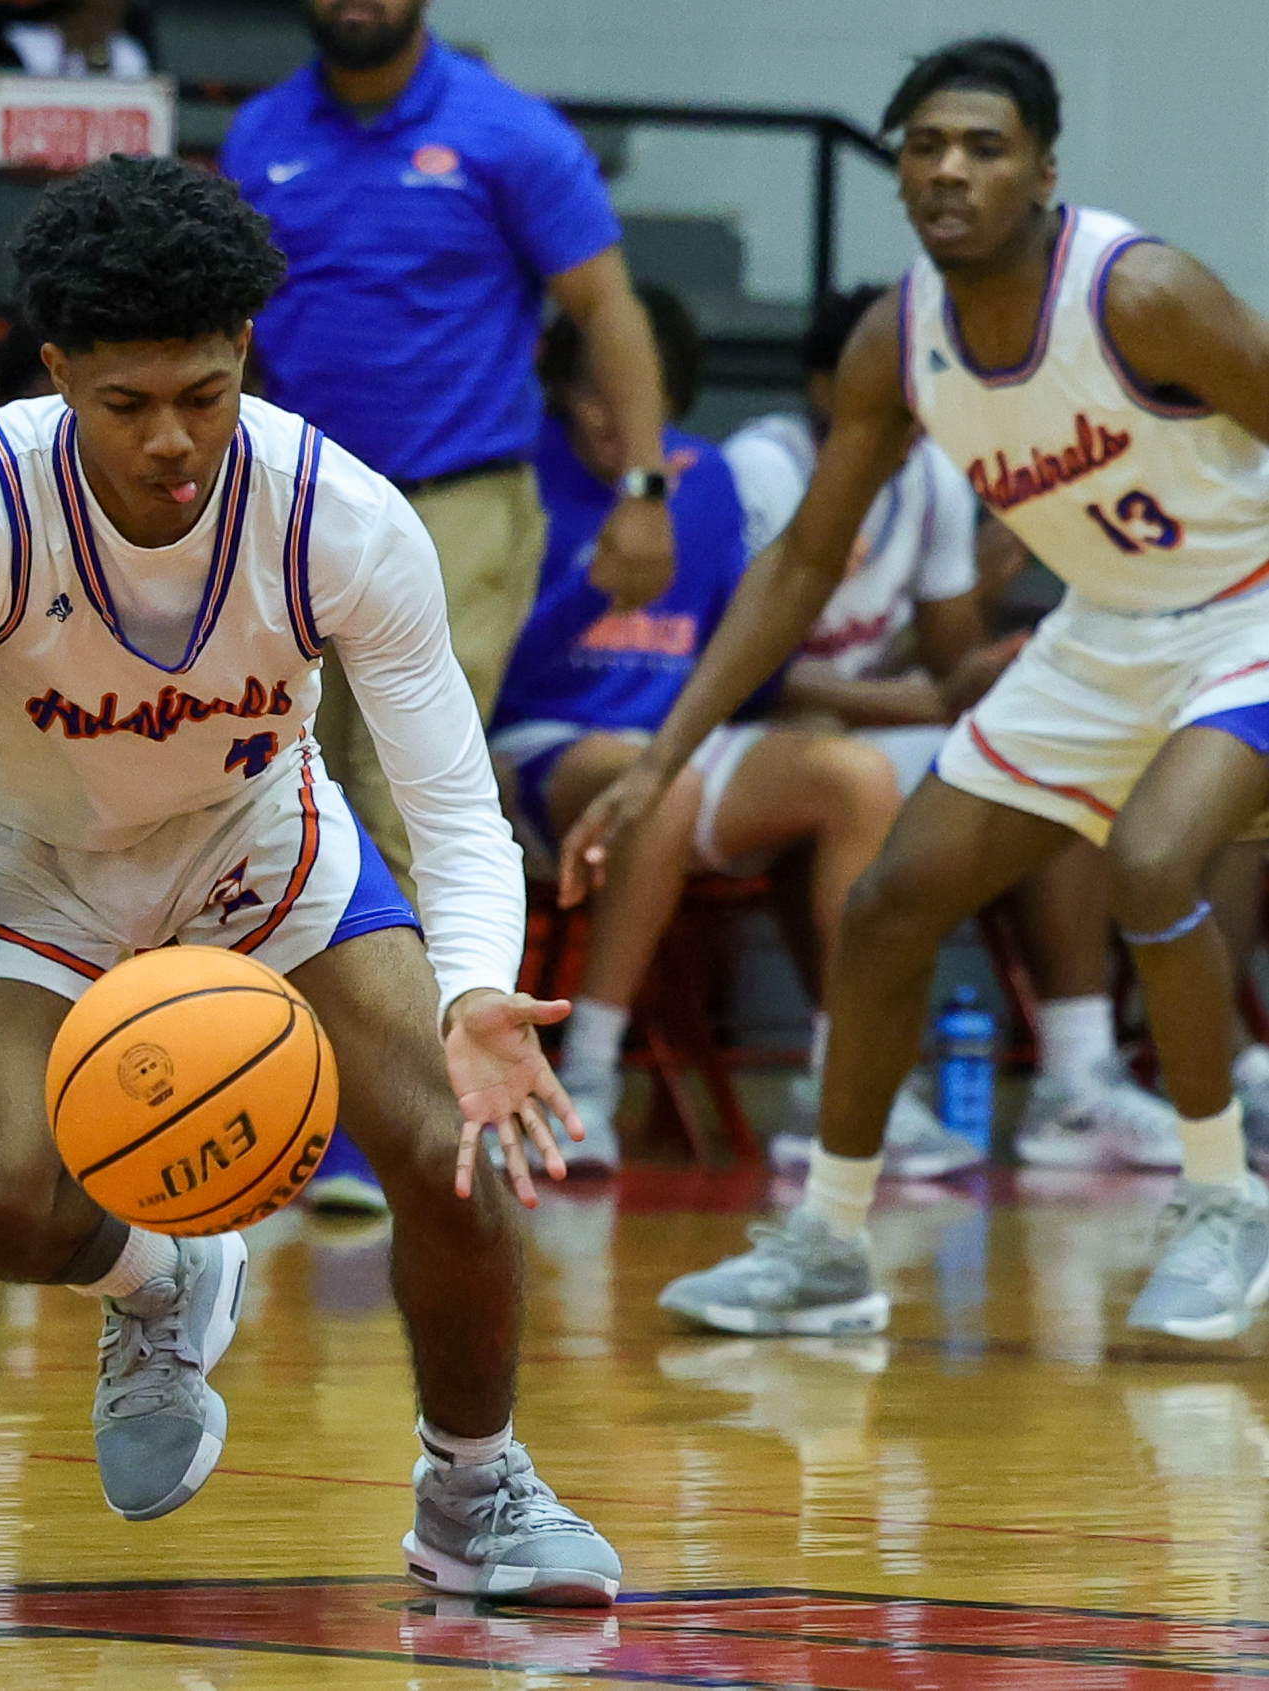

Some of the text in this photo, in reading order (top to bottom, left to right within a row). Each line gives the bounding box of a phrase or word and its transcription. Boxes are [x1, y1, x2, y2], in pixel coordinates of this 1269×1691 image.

[967, 412, 1131, 514] Admirals
[1085, 488, 1183, 556] 13
[224, 731, 279, 780] 4
[160, 1108, 258, 1199] EVO
